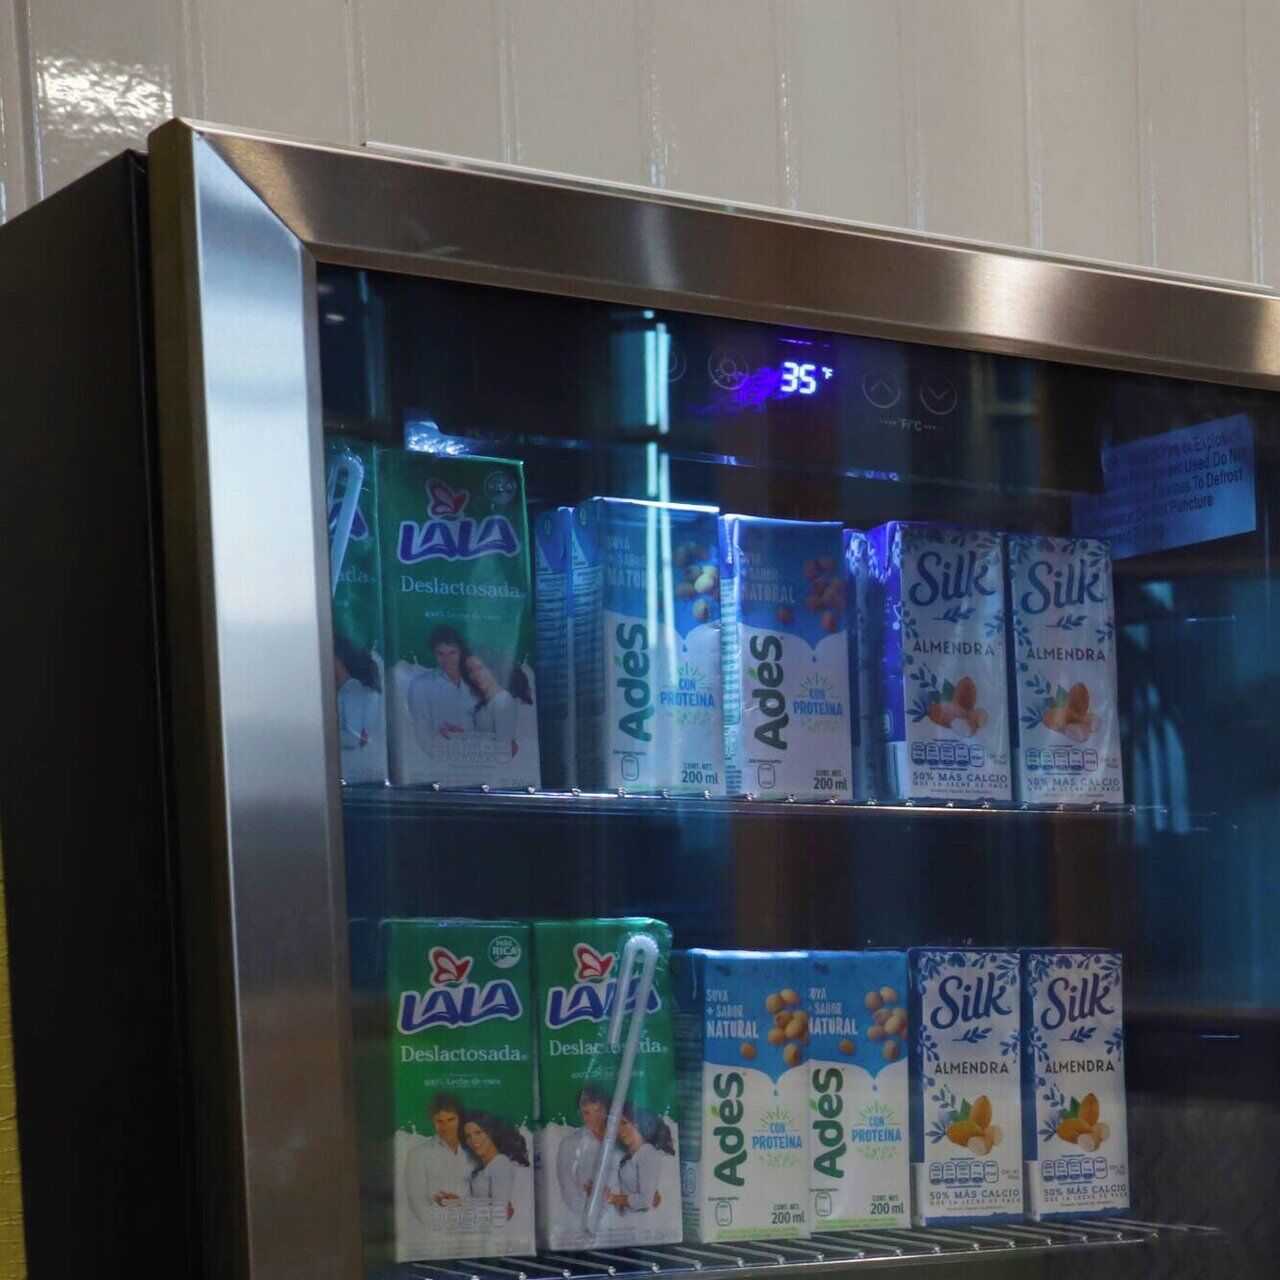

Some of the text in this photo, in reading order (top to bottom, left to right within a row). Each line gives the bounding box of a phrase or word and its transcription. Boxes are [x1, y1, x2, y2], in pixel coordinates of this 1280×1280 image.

[909, 551, 996, 606] Silk
[401, 576, 521, 598] Deslactosada
[1020, 559, 1107, 615] Silk
[913, 640, 995, 656] ALMENDRA
[1027, 648, 1106, 661] ALMENDRA
[682, 771, 703, 784] 200
[814, 778, 833, 790] 200
[706, 989, 728, 1002] SOYA
[930, 972, 1012, 1030] Silk
[1040, 972, 1115, 1030] Silk
[399, 981, 521, 1033] LALA
[716, 1004, 744, 1018] SABOR
[707, 1020, 759, 1039] NATURAL
[401, 1045, 521, 1063] Deslactosada
[934, 1061, 1009, 1075] ALMENDRA
[1045, 1060, 1115, 1073] ALMENDRA
[869, 1115, 885, 1126] CON
[769, 1122, 787, 1134] CON
[981, 1188, 1020, 1198] CALCIO
[1091, 1184, 1127, 1193] CALCIO
[871, 1202, 904, 1215] 200 ml
[772, 1211, 805, 1224] 200 ml
